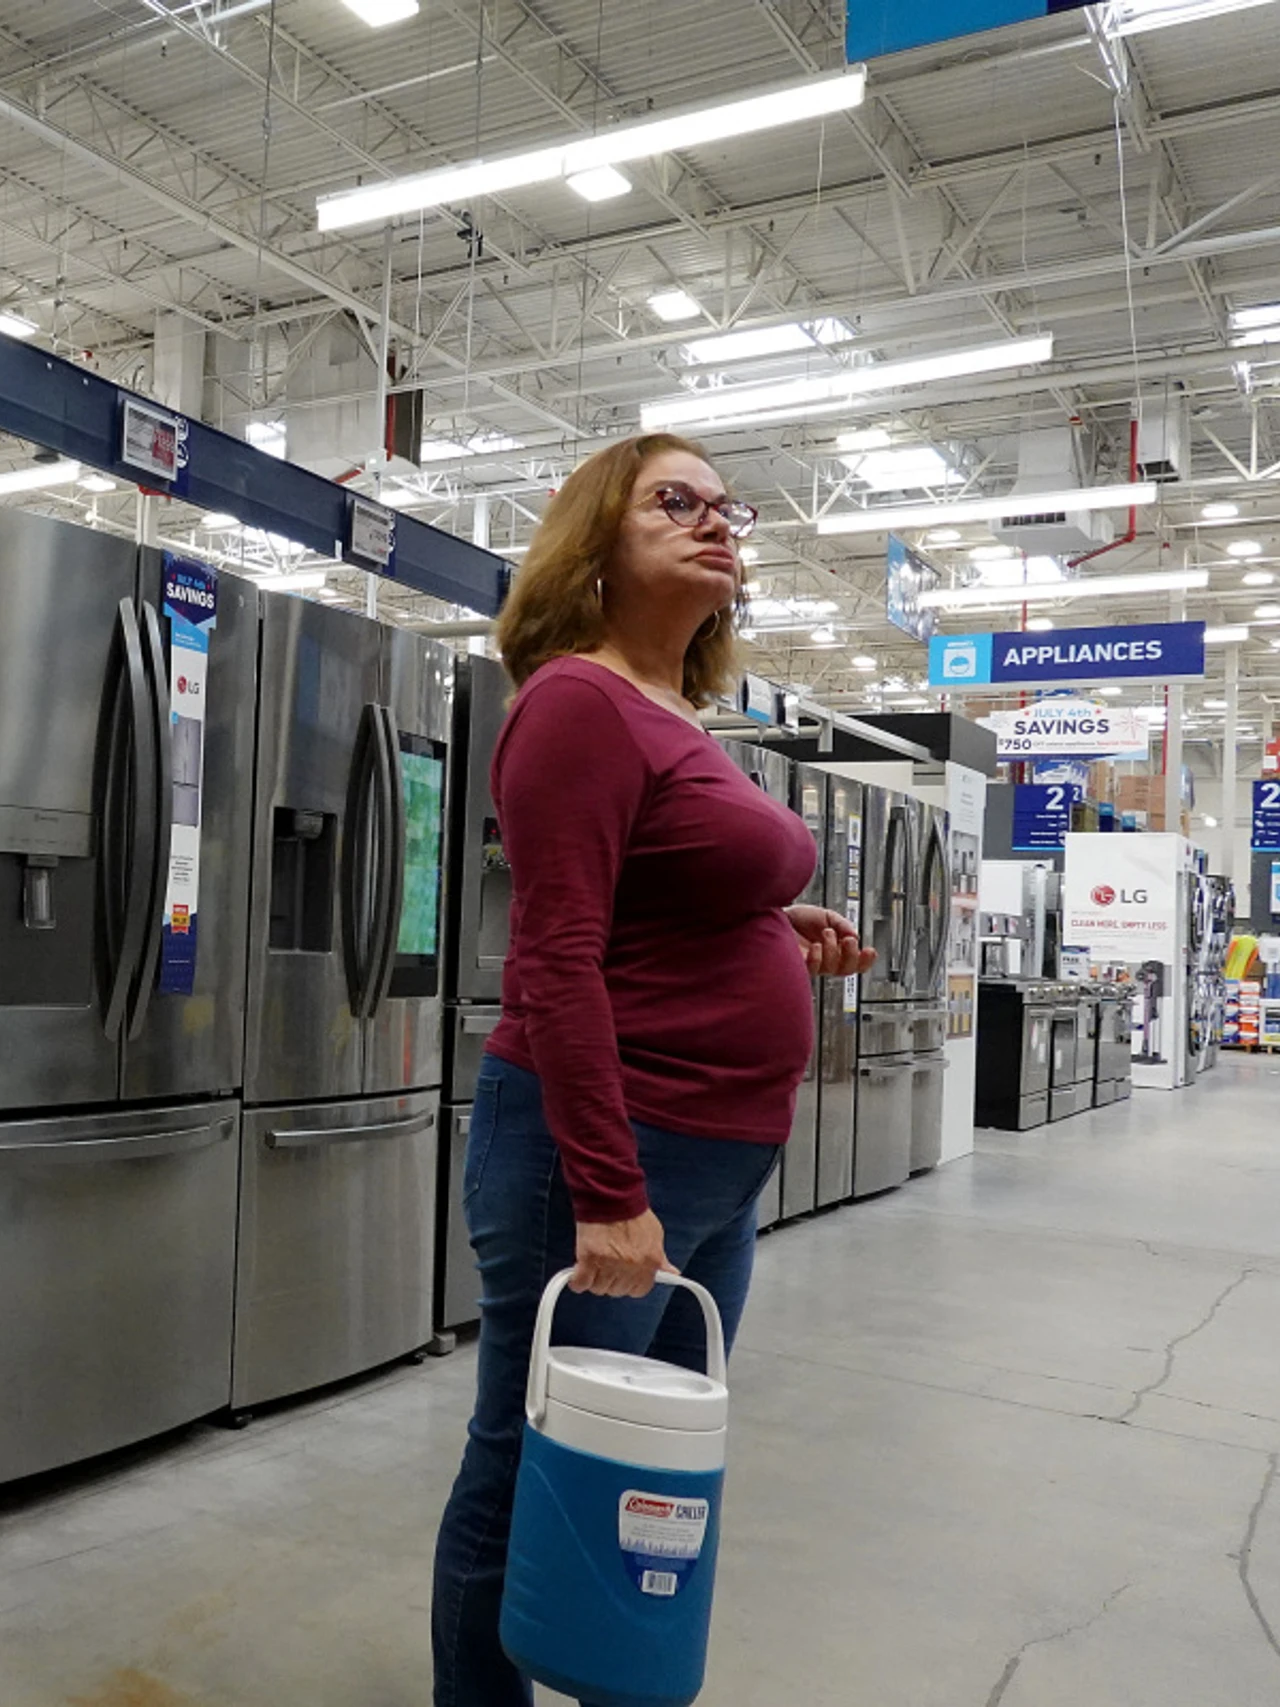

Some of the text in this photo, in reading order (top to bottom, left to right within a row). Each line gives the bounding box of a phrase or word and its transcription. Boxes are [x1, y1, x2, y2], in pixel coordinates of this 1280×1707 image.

[166, 582, 214, 609] SAVINGS
[1002, 640, 1162, 667] APPLIANCES
[188, 681, 200, 694] LG
[1034, 708, 1091, 718] JULY 4th
[1014, 719, 1110, 735] SAVINGS
[1045, 786, 1065, 810] 2
[1261, 783, 1280, 808] 2
[1120, 889, 1148, 904] LG
